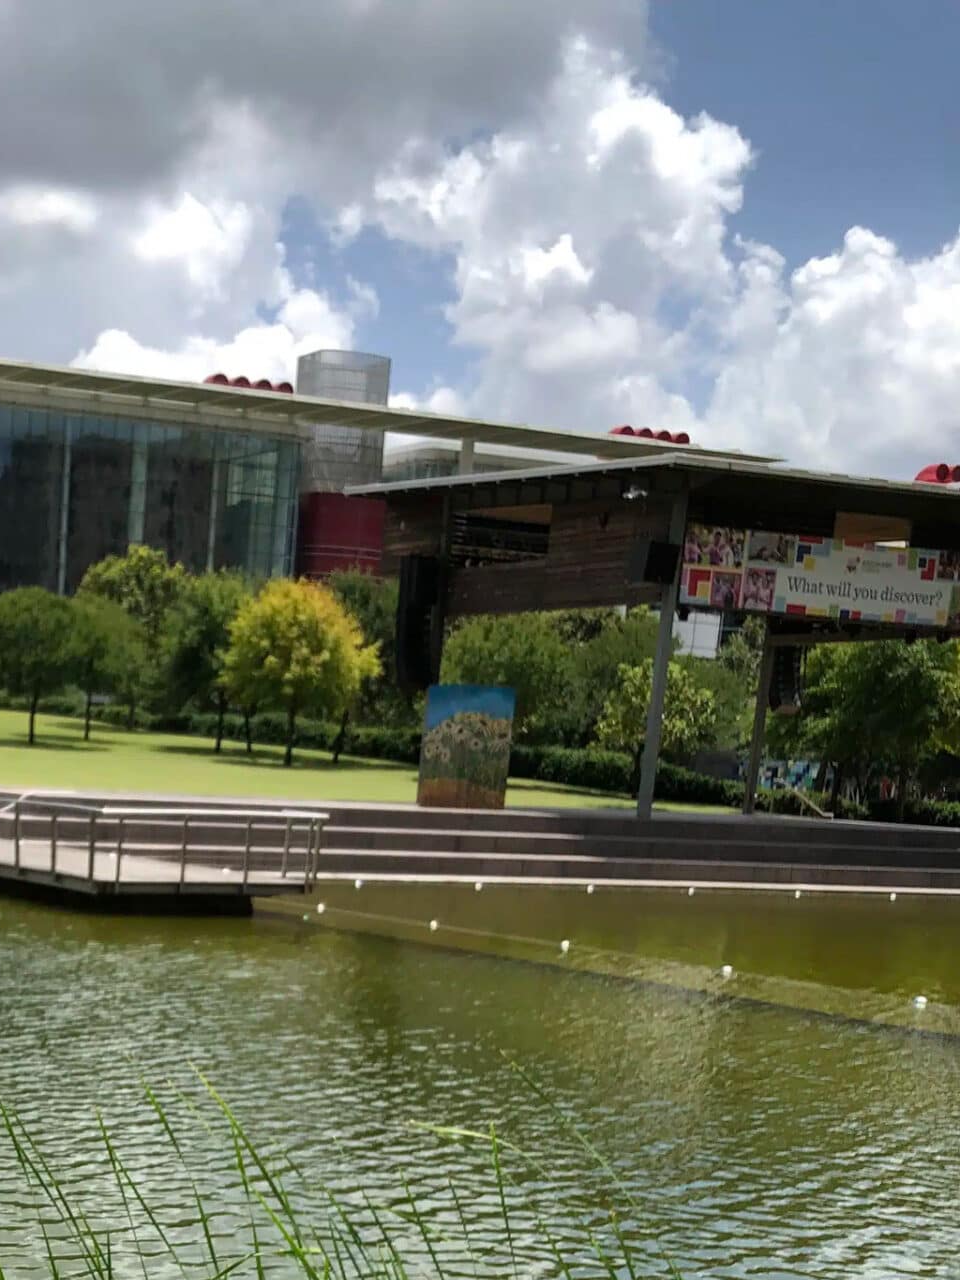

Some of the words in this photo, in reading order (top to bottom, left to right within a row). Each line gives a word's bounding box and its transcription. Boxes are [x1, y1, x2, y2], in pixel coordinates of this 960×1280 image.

[787, 576, 823, 594] What
[826, 580, 851, 598] will
[853, 588, 878, 601] you
[881, 586, 944, 607] discover?
